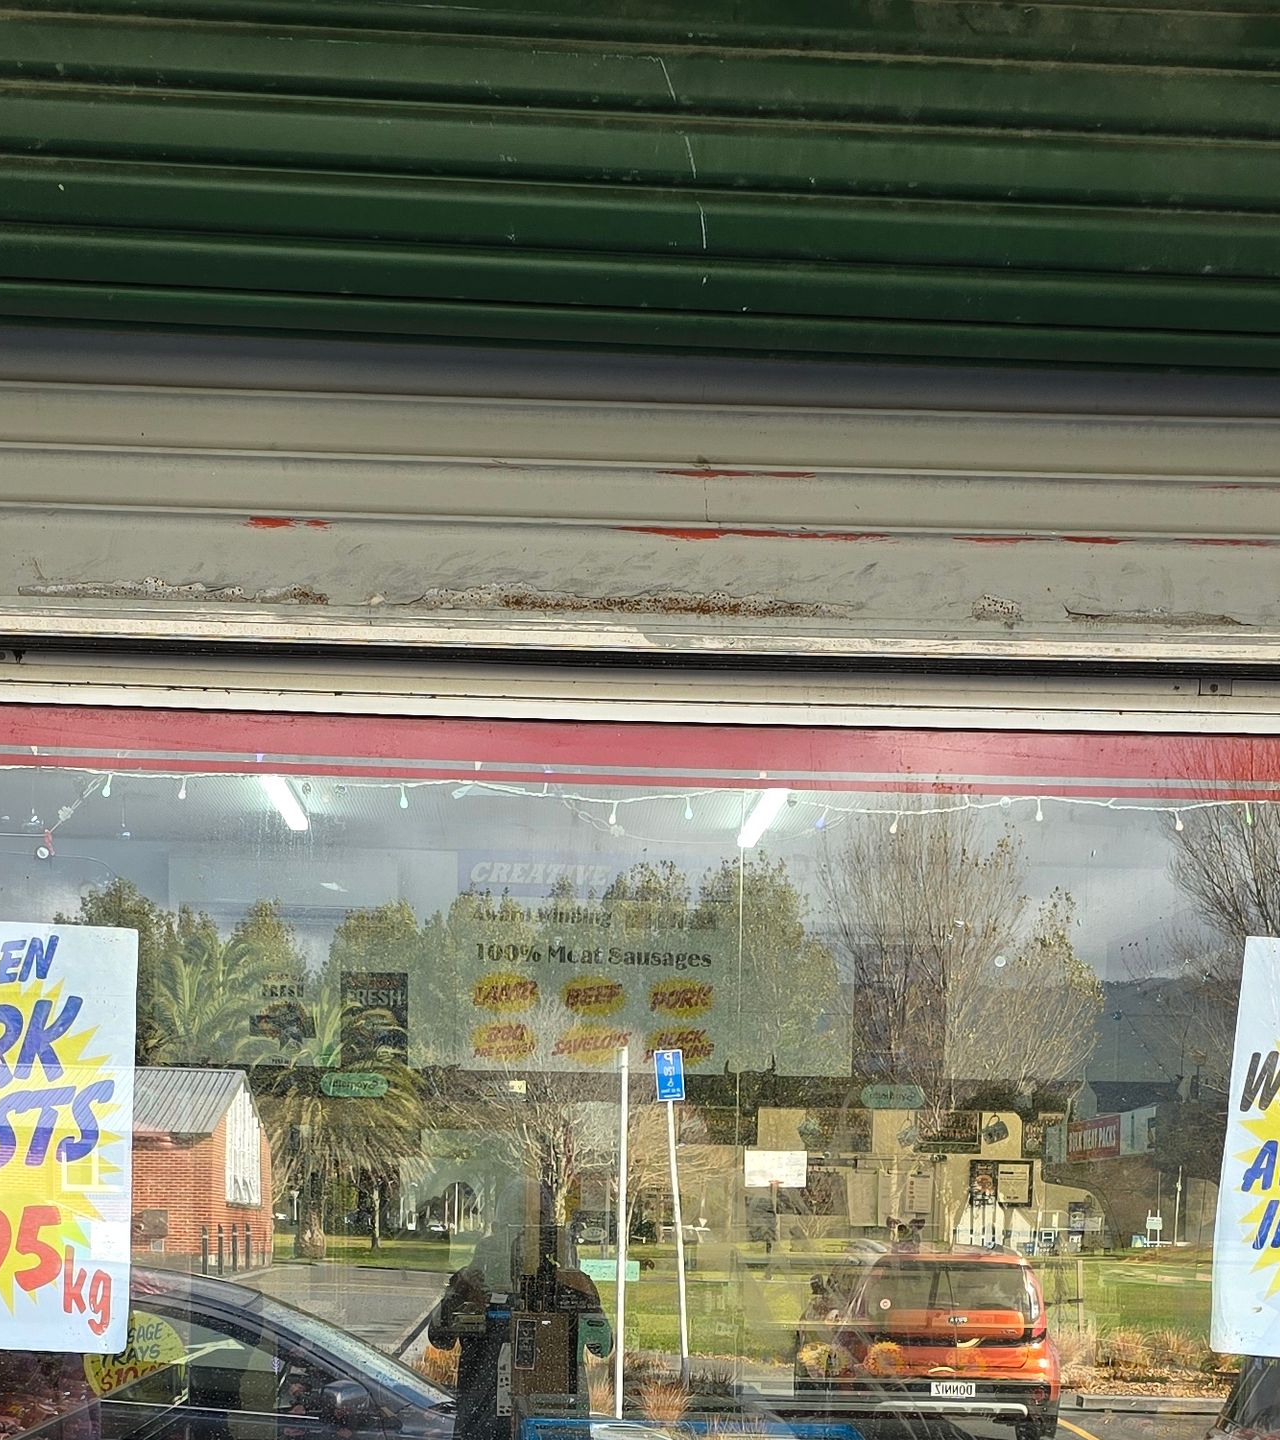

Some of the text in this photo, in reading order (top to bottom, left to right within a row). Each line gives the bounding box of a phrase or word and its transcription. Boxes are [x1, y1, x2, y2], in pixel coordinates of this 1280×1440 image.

[470, 862, 613, 885] CREATIVE
[476, 943, 712, 970] 100% Meat Sausages
[347, 989, 402, 1006] FRESH
[650, 984, 714, 1011] PORK
[127, 1321, 164, 1344] SAGE
